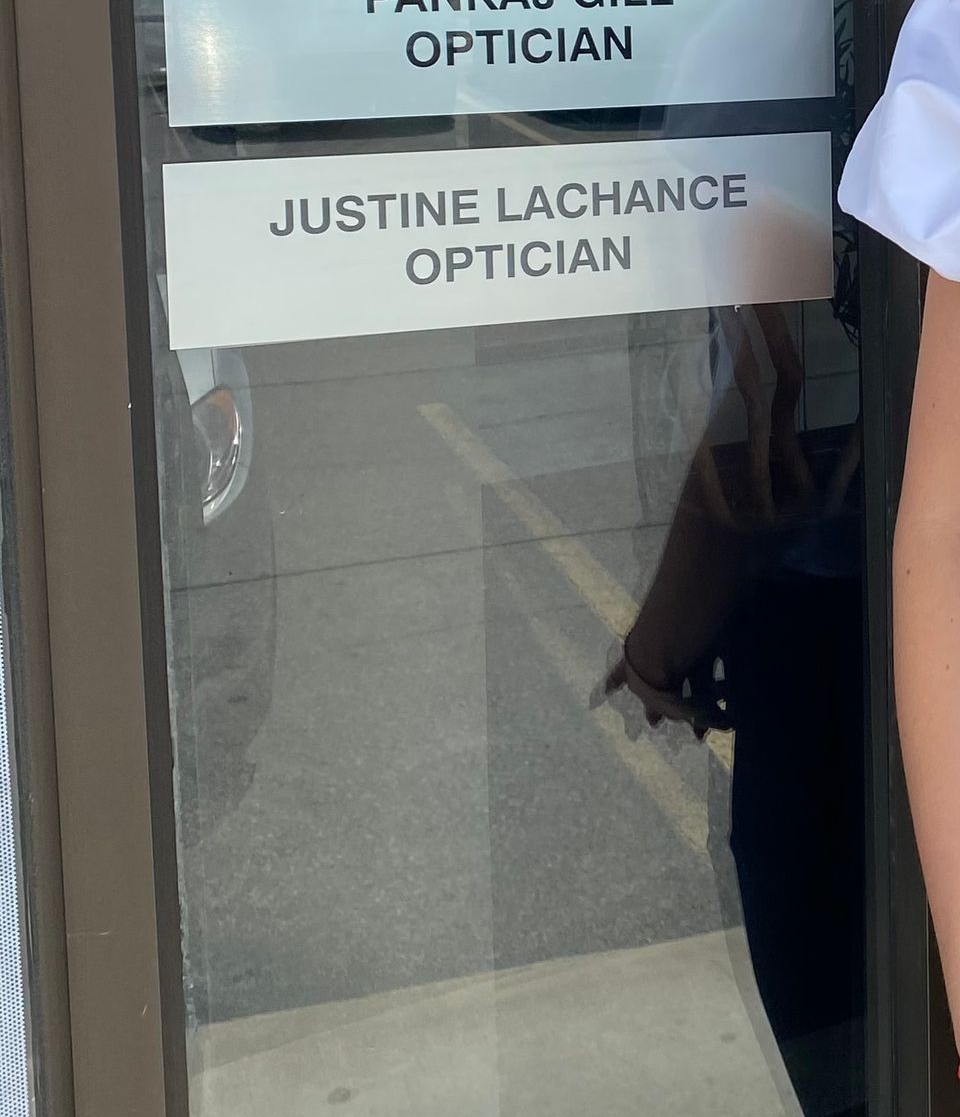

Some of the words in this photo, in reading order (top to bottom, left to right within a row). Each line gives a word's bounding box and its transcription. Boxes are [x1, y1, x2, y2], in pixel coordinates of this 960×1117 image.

[407, 26, 632, 67] OPTICIAN
[270, 189, 479, 236] JUSTINE
[498, 174, 748, 222] LACHANCE
[406, 236, 631, 285] OPTICIAN
